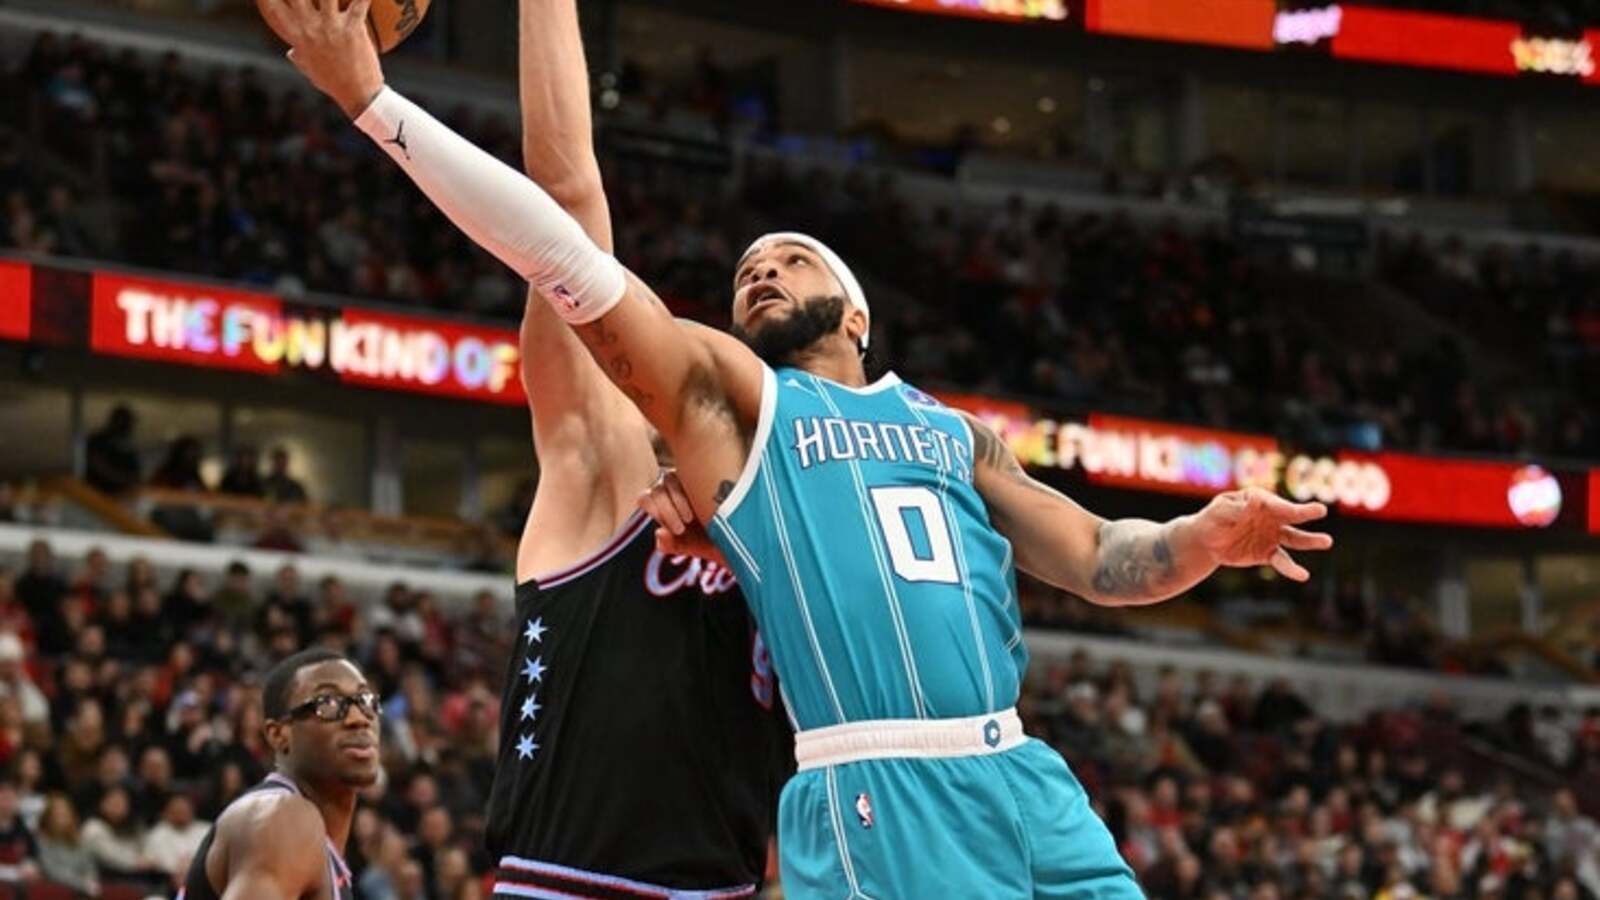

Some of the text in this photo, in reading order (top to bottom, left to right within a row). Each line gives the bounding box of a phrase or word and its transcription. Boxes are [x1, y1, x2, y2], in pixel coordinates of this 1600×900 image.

[116, 289, 519, 394] THE FUN KIND OF
[793, 415, 974, 486] HORNETS
[1286, 454, 1392, 511] GOOD
[867, 484, 961, 585] 0
